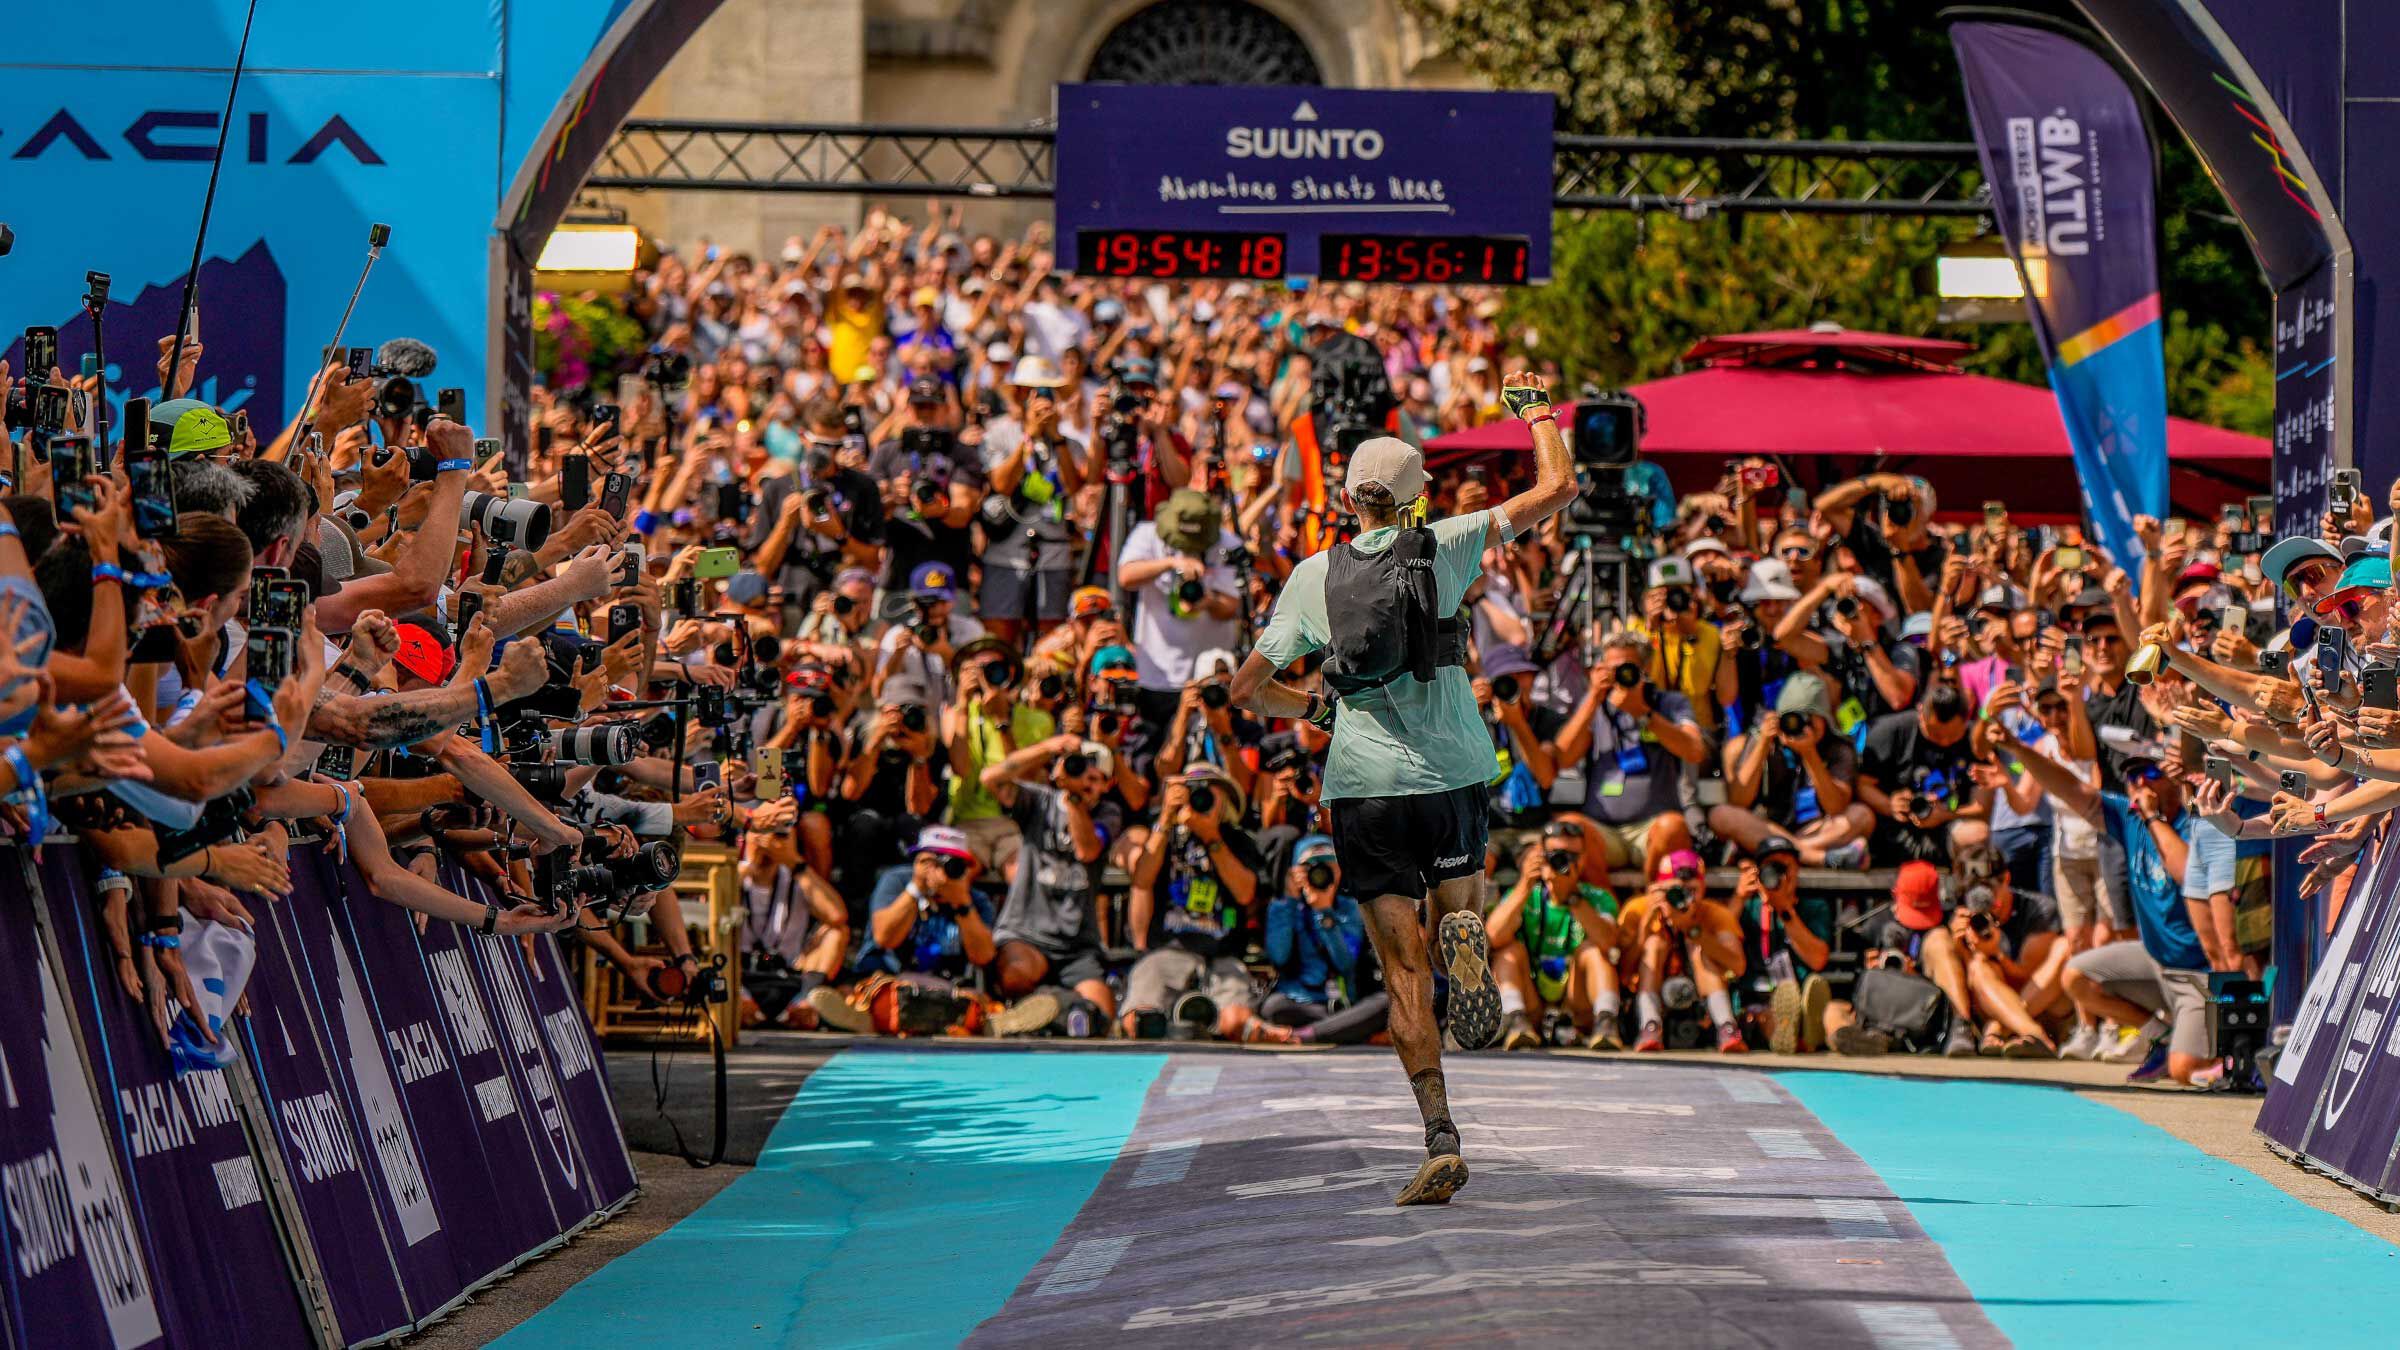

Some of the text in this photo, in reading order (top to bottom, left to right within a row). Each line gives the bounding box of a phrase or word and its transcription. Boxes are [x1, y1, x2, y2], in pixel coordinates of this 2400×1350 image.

[0, 108, 387, 166] ACIA
[1226, 126, 1385, 160] SUUNTO
[1095, 233, 1284, 279] 19:54:18
[1338, 239, 1527, 282] 13:56:11
[1433, 854, 1470, 869] HOKA
[429, 948, 495, 1057] HOKA
[388, 1019, 450, 1084] DACIA
[119, 1080, 196, 1158] DACIA
[281, 1089, 355, 1184] SUUNTO
[2, 1146, 76, 1279] SUUNTO
